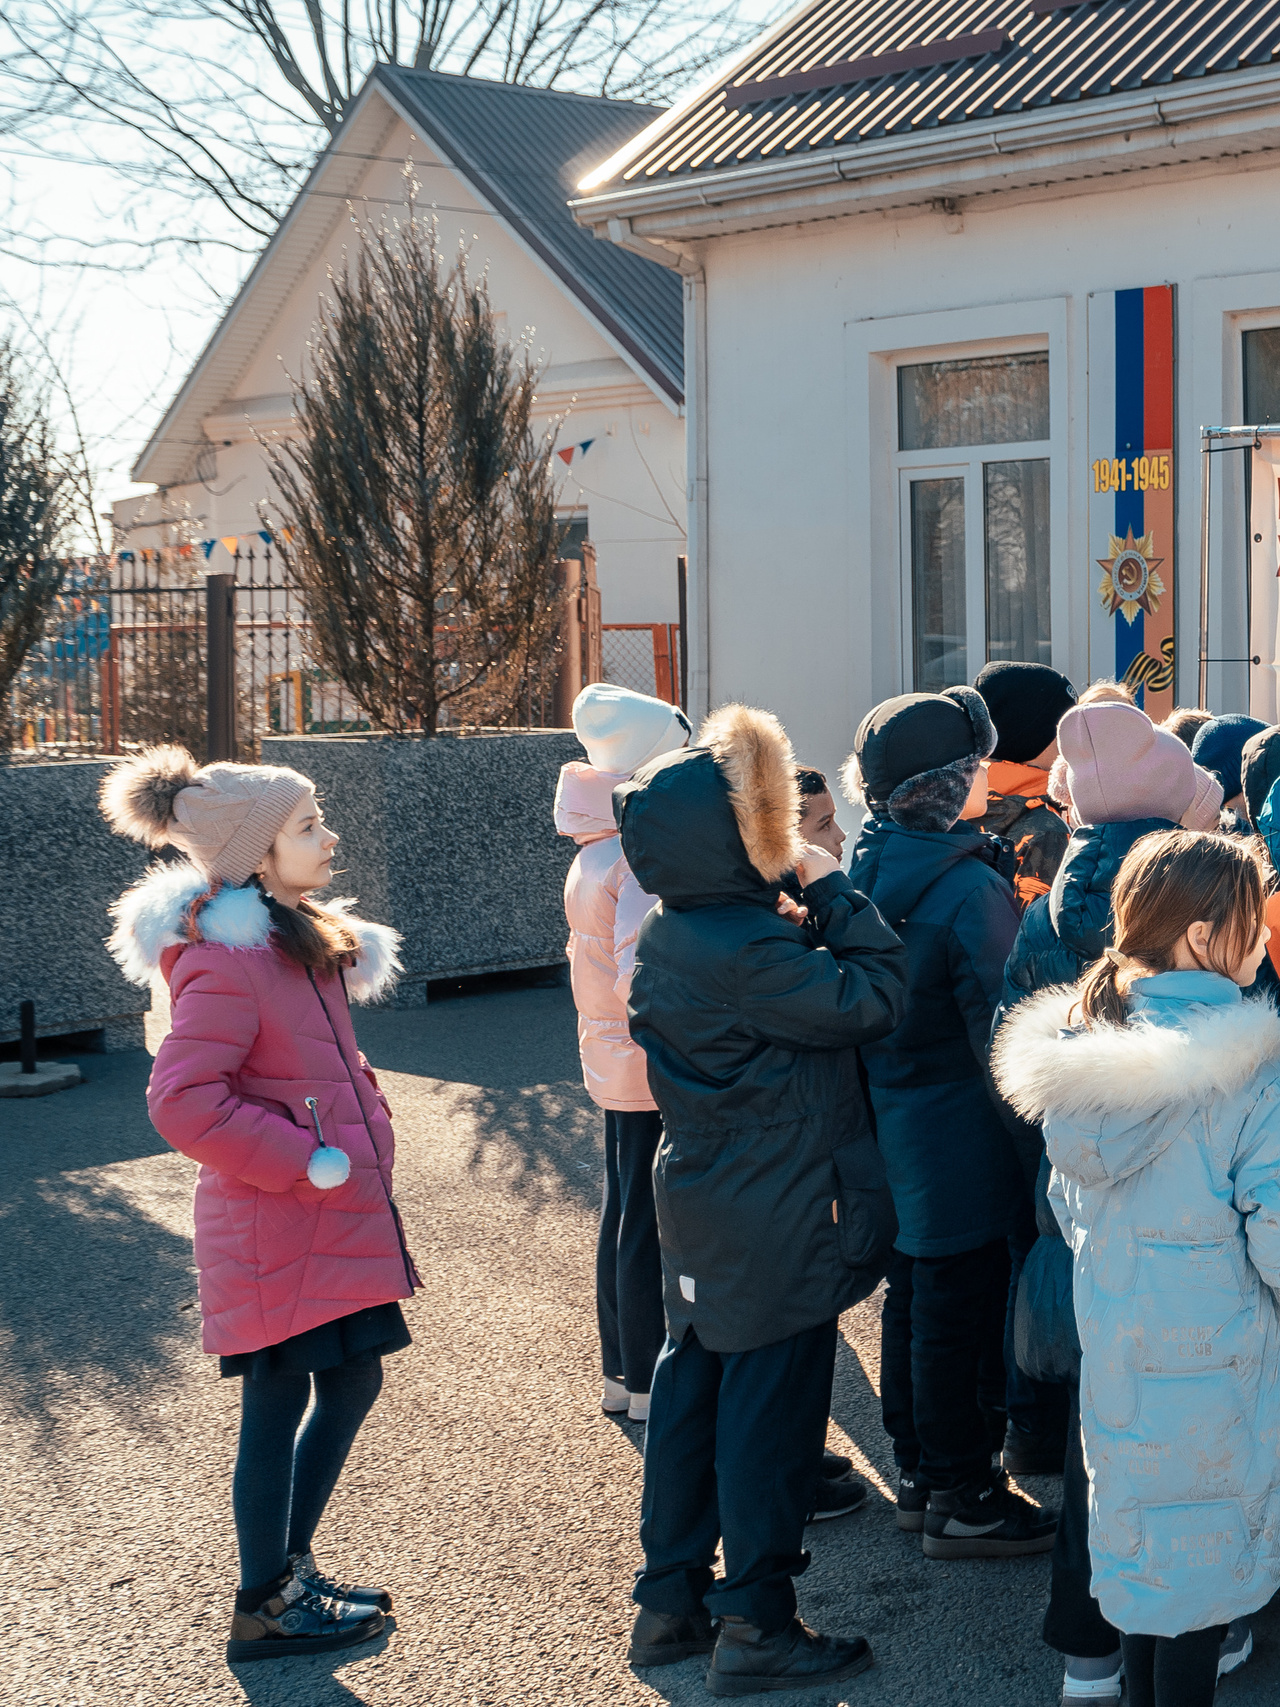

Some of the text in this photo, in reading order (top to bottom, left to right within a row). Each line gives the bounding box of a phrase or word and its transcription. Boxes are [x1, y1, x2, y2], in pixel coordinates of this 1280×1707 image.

[1092, 456, 1169, 492] 1941-1945
[1177, 1343, 1213, 1358] CLUB
[901, 1479, 915, 1488] FILA
